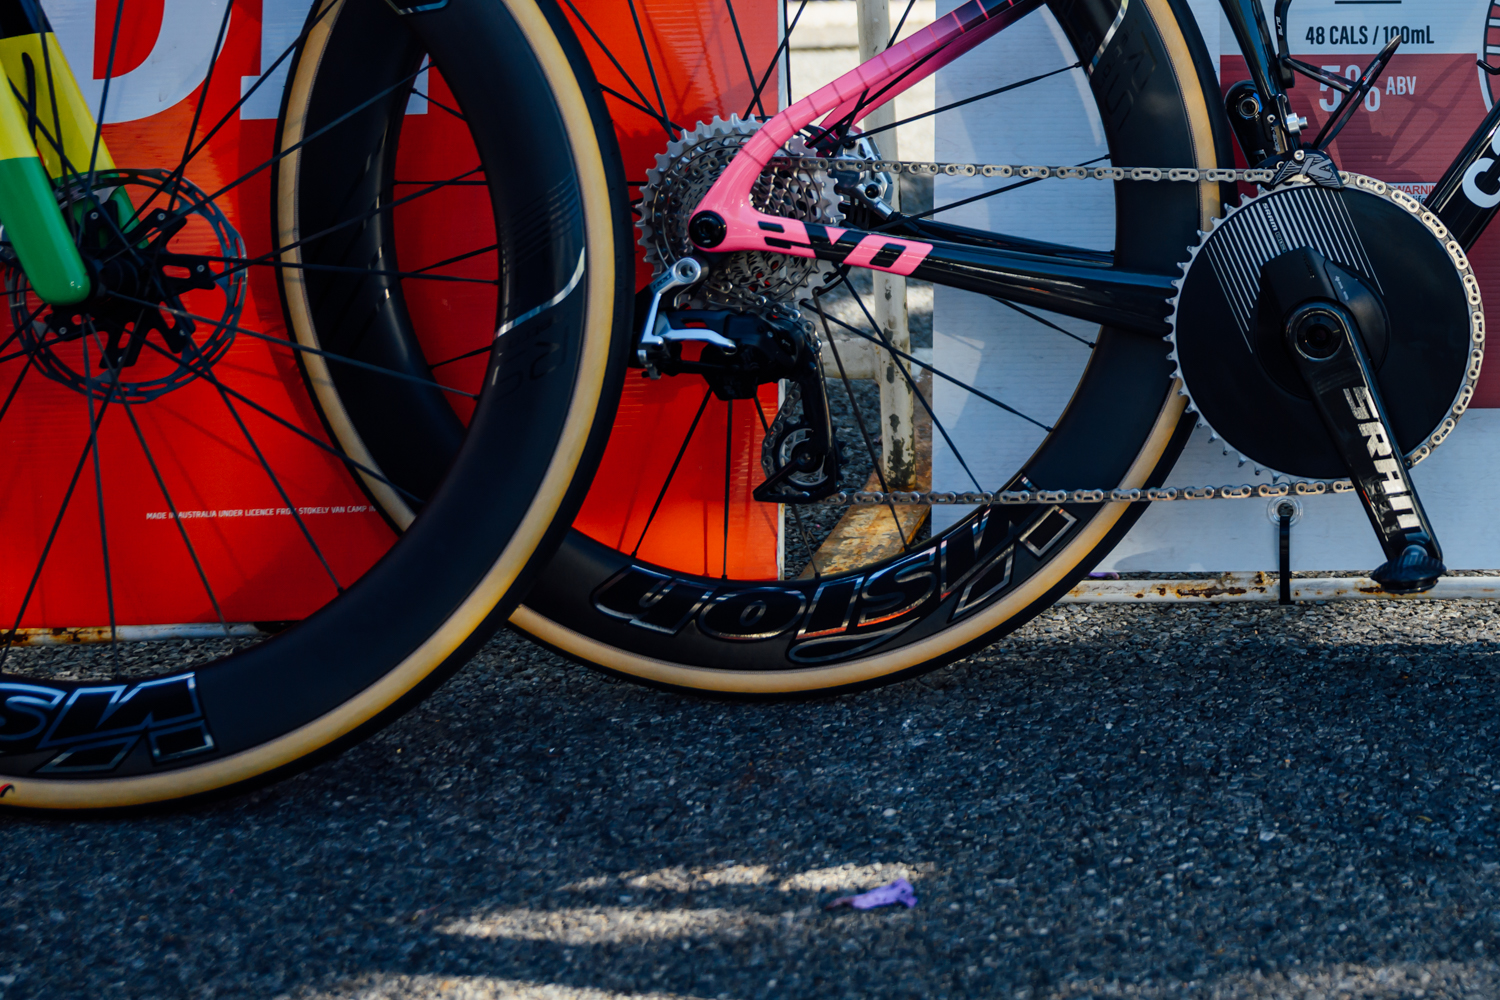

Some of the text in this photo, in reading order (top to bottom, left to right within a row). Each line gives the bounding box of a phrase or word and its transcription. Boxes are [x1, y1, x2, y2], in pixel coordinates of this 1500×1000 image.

[1305, 26, 1325, 45] 48
[1329, 25, 1368, 45] CALS
[1383, 25, 1435, 45] 100mL
[1385, 75, 1417, 96] ABV
[1261, 202, 1279, 232] SRAM
[1342, 386, 1431, 545] SRAM
[146, 511, 168, 520] MADE
[177, 510, 217, 519] AUSTRALIA
[218, 509, 243, 517] UNDER
[245, 508, 274, 517] LICENCE
[299, 506, 329, 515] STOKELY
[331, 506, 345, 514] VAN
[347, 505, 367, 513] CAMP
